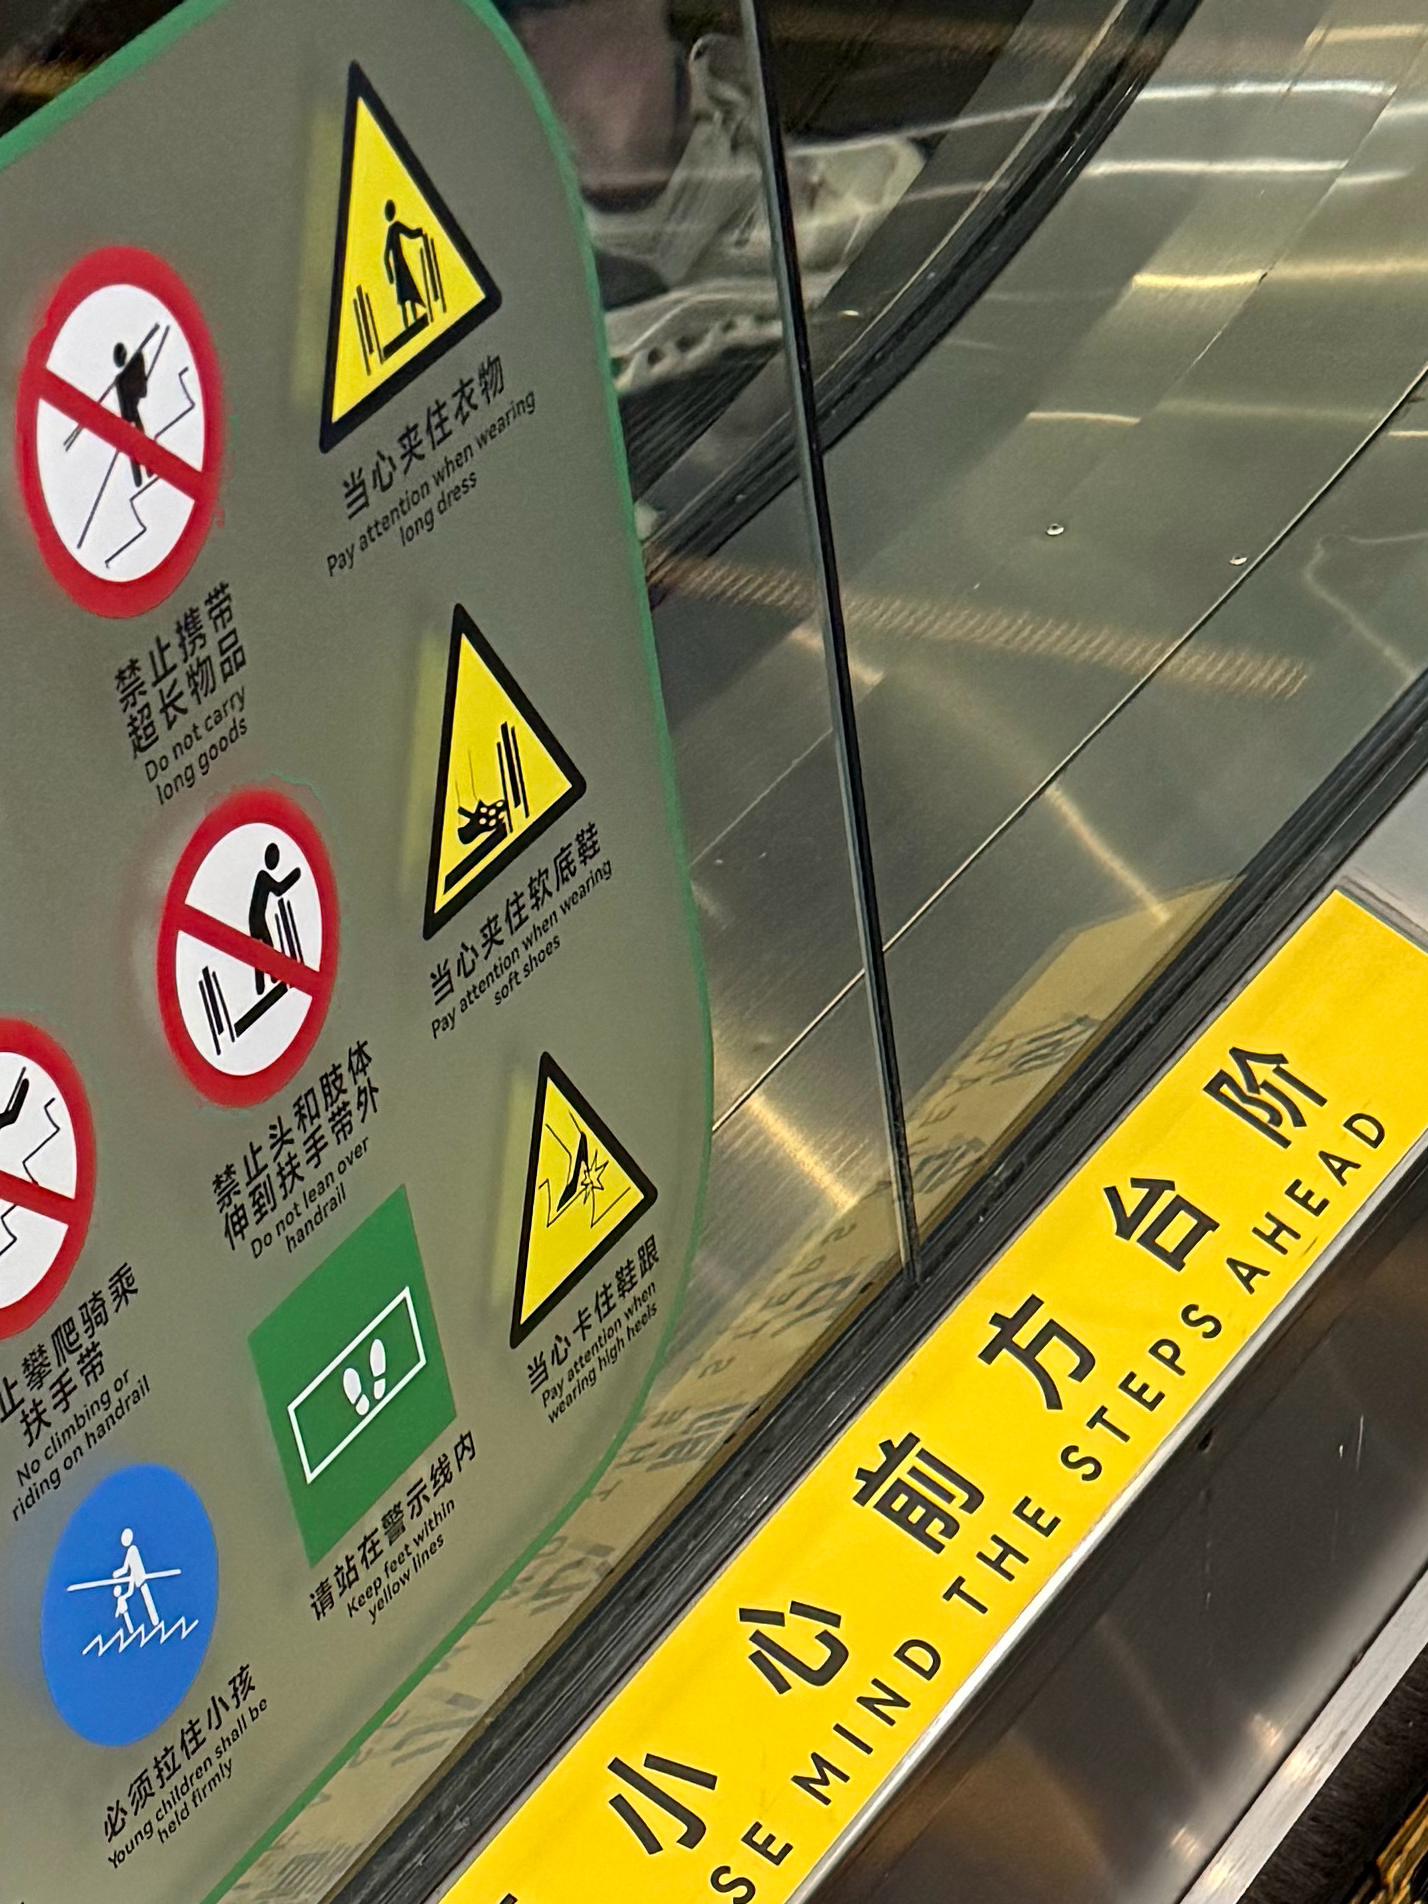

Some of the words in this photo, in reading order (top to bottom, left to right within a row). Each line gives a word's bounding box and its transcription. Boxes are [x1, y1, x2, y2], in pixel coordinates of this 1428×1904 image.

[327, 542, 355, 576] Pay
[359, 481, 430, 551] attention
[432, 444, 474, 487] when
[476, 390, 536, 449] wearing
[343, 355, 504, 520] 当心夹住衣物
[400, 509, 435, 546] long
[437, 471, 478, 515] dress
[115, 581, 233, 713] 禁止携带
[127, 628, 247, 759] 超长物品
[144, 755, 169, 783] Do
[173, 723, 203, 760] not
[204, 686, 246, 731] carry
[156, 763, 195, 805] long
[198, 717, 248, 776] goods
[430, 822, 600, 1005] 当心夹住软底鞋
[431, 1007, 456, 1039] Pay
[460, 947, 520, 1013] attention
[522, 910, 559, 951] when
[559, 859, 613, 915] wearing
[495, 970, 522, 1005] soft
[523, 935, 561, 978] shoes
[212, 1040, 372, 1214] 禁止头和肢体
[224, 1077, 379, 1251] 伸到扶手带外
[250, 1232, 273, 1259] Do
[275, 1203, 302, 1236] not
[303, 1171, 335, 1209] lean
[337, 1137, 369, 1175] over
[285, 1182, 347, 1253] handrail
[527, 1234, 659, 1394] 当心卡住鞋跟
[542, 1378, 564, 1408] Pay
[567, 1317, 622, 1382] attention
[624, 1282, 656, 1321] when
[548, 1367, 597, 1423] wearing
[597, 1338, 625, 1372] high
[626, 1302, 658, 1341] heels
[12, 1467, 62, 1521] riding
[63, 1446, 84, 1470] on
[84, 1375, 152, 1450] handrail
[16, 1459, 40, 1486] No
[44, 1391, 112, 1461] climbing
[113, 1369, 130, 1393] or
[20, 1341, 105, 1448] 扶手带
[797, 1636, 949, 1807] MIND
[941, 1496, 1064, 1625] THE
[1061, 1301, 1224, 1484] STEPS
[1224, 1105, 1391, 1299] AHEAD
[309, 1430, 476, 1621] 请站在警示线内
[347, 1576, 382, 1618] Keep
[384, 1543, 412, 1578] feet
[413, 1499, 455, 1547] within
[368, 1570, 411, 1625] yellow
[412, 1534, 444, 1573] lines
[104, 1664, 255, 1843] 必须拉住小孩
[108, 1819, 154, 1869] Young
[155, 1757, 212, 1822] children
[215, 1713, 248, 1760] shall
[248, 1698, 268, 1722] be
[157, 1802, 190, 1844] held
[192, 1757, 233, 1808] firmly
